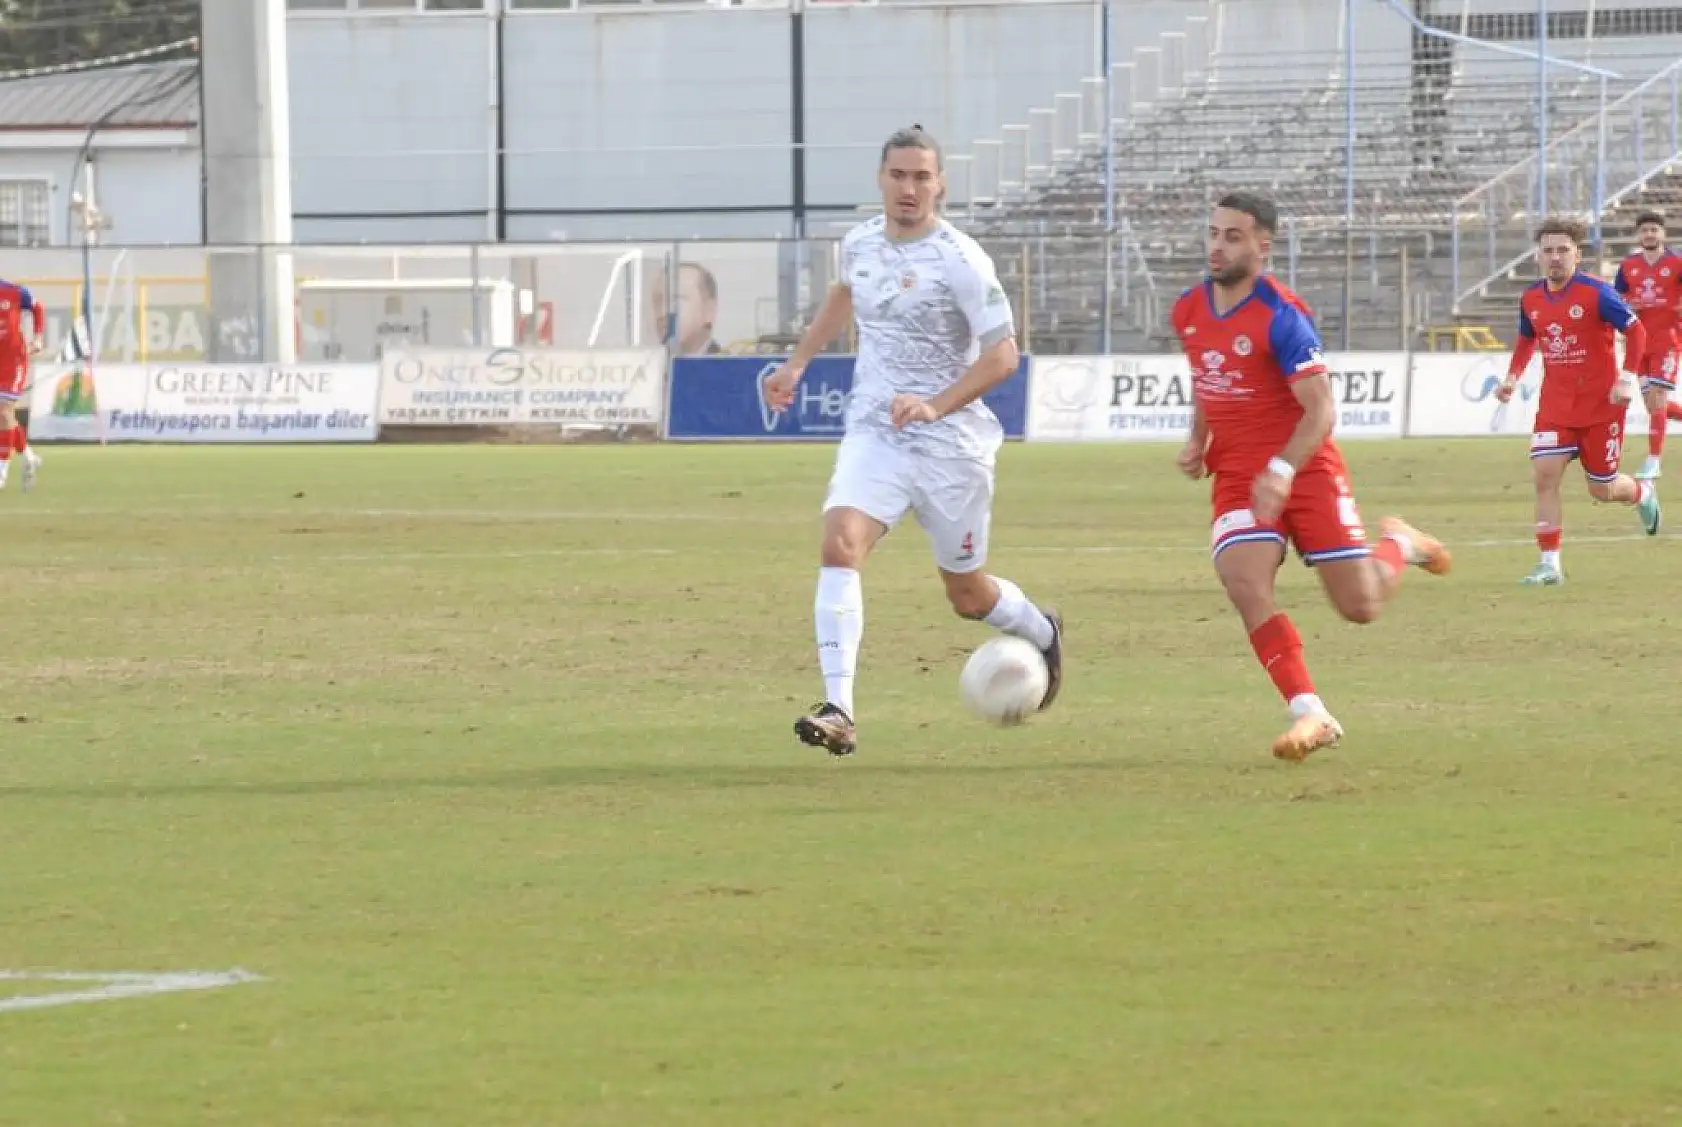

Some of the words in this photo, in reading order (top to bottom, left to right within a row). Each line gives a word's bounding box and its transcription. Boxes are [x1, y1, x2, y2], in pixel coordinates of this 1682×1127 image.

[155, 367, 255, 393] GREEN
[264, 367, 333, 393] PINE
[1109, 374, 1195, 406] PEA
[1327, 370, 1396, 404] TEL
[412, 389, 523, 404] INSURANCE
[529, 389, 629, 404] COMPANY
[325, 408, 369, 429] diler
